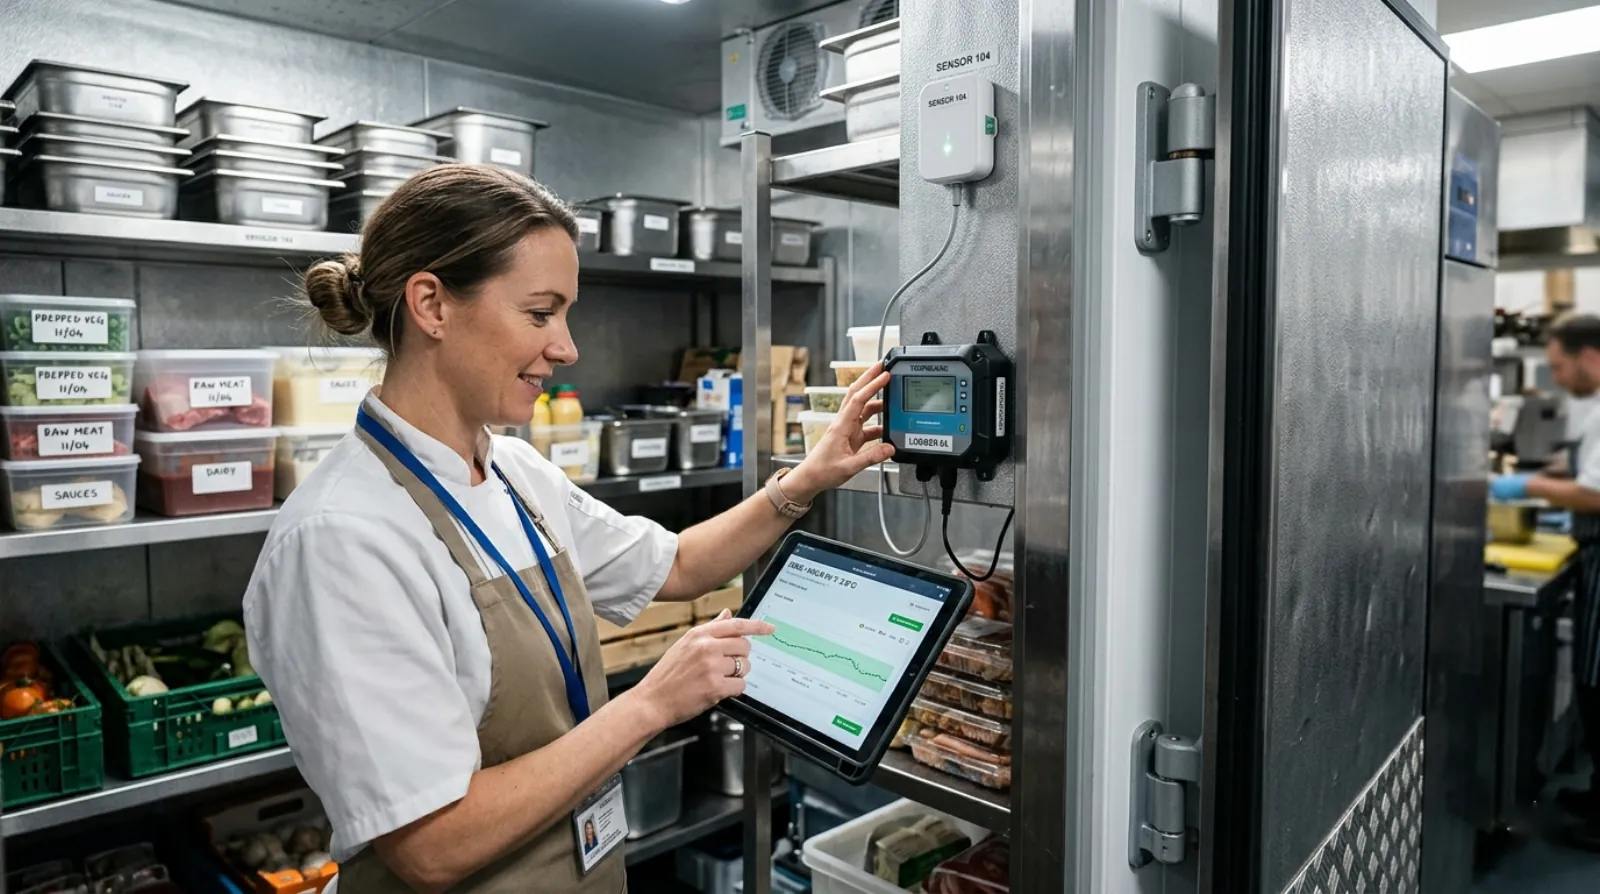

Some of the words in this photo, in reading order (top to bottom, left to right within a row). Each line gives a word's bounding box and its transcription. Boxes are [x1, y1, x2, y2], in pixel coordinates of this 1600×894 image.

[936, 55, 973, 72] SENSOR
[975, 51, 991, 62] 104
[956, 93, 967, 102] 104
[74, 425, 104, 436] MEAT
[61, 439, 89, 451] 11/04
[54, 488, 98, 500] SAUCES
